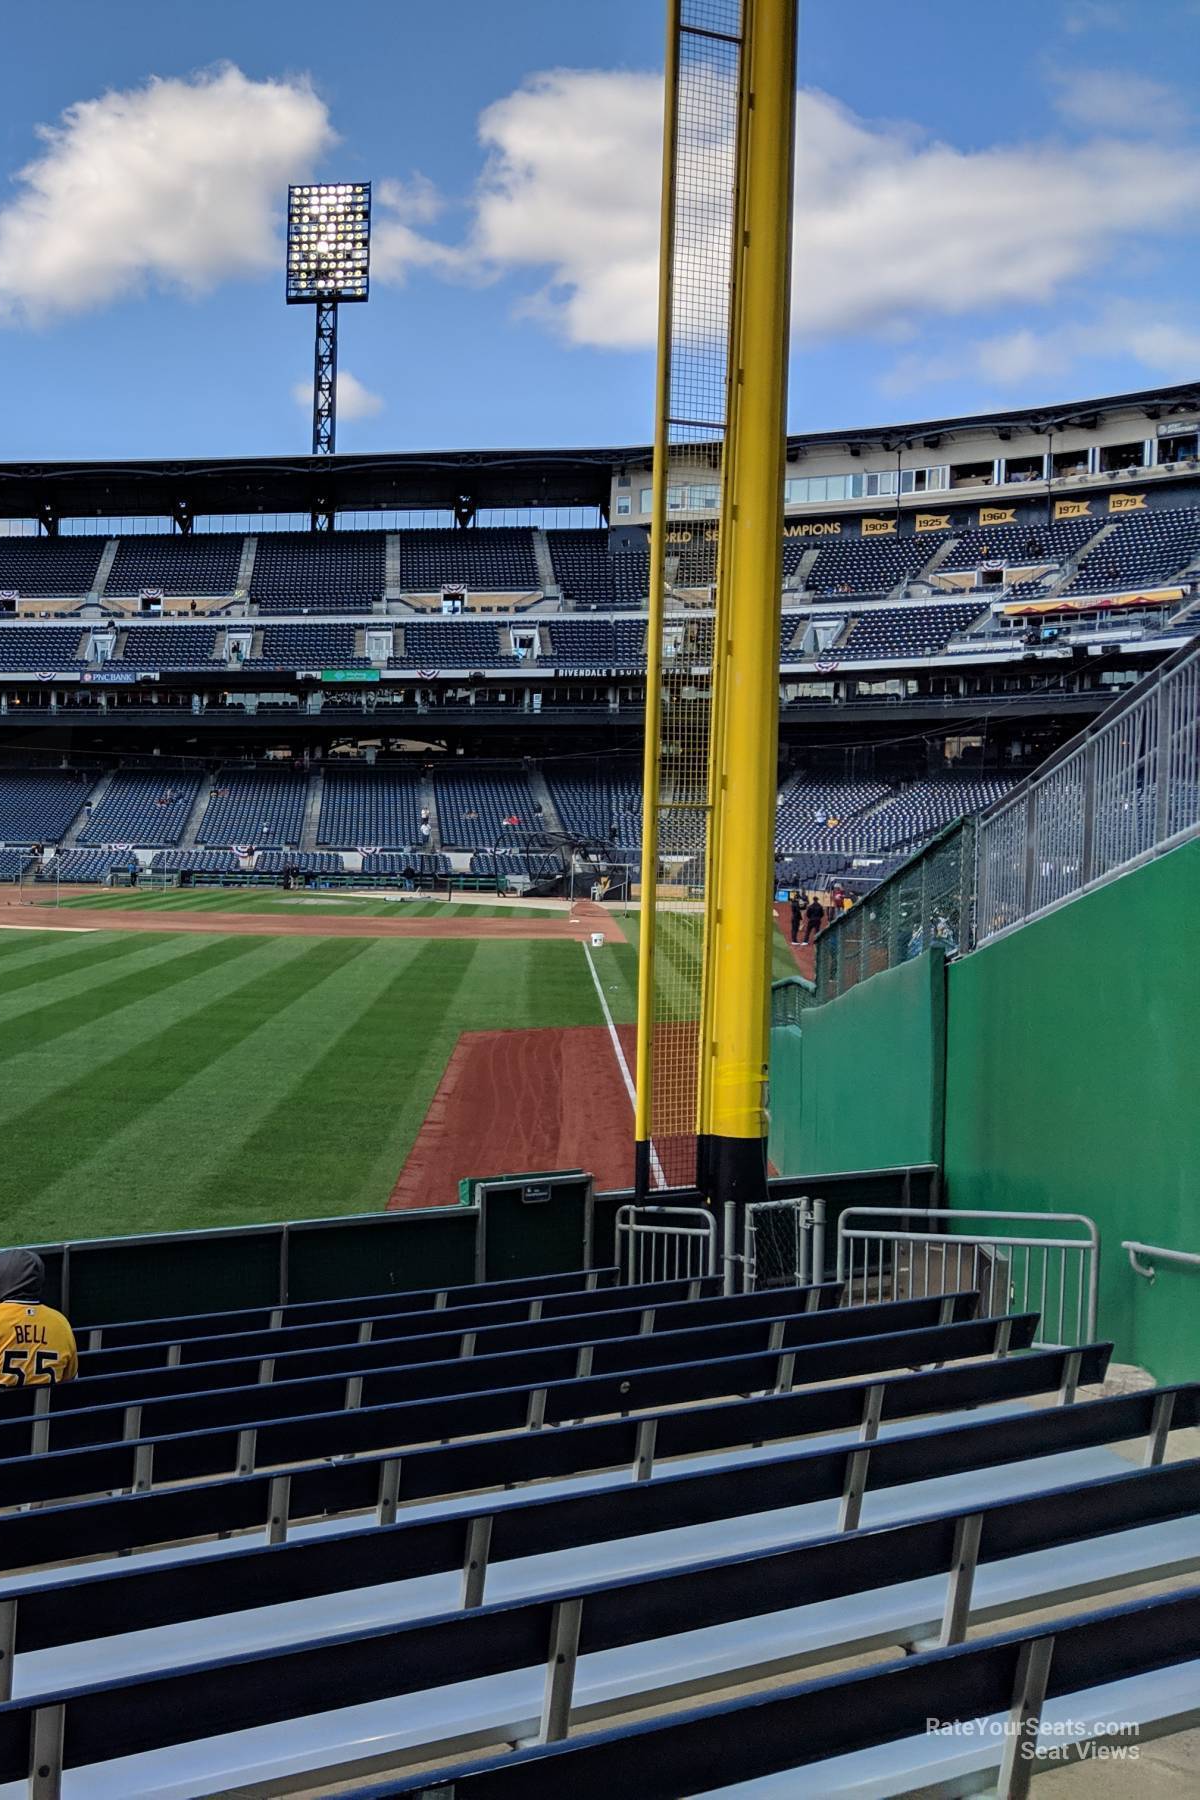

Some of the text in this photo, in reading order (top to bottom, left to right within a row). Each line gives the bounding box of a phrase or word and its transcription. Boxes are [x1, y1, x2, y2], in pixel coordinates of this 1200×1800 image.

[1112, 498, 1137, 508] 1979
[1059, 505, 1080, 514] 1971
[982, 512, 1007, 521] 1960
[865, 523, 888, 531] 1909
[919, 519, 942, 527] 1925
[647, 531, 691, 543] RLD
[784, 522, 841, 537] AMPIONS
[93, 673, 132, 681] PNC BANK
[15, 1325, 48, 1344] BELL
[0, 1350, 59, 1388] 55
